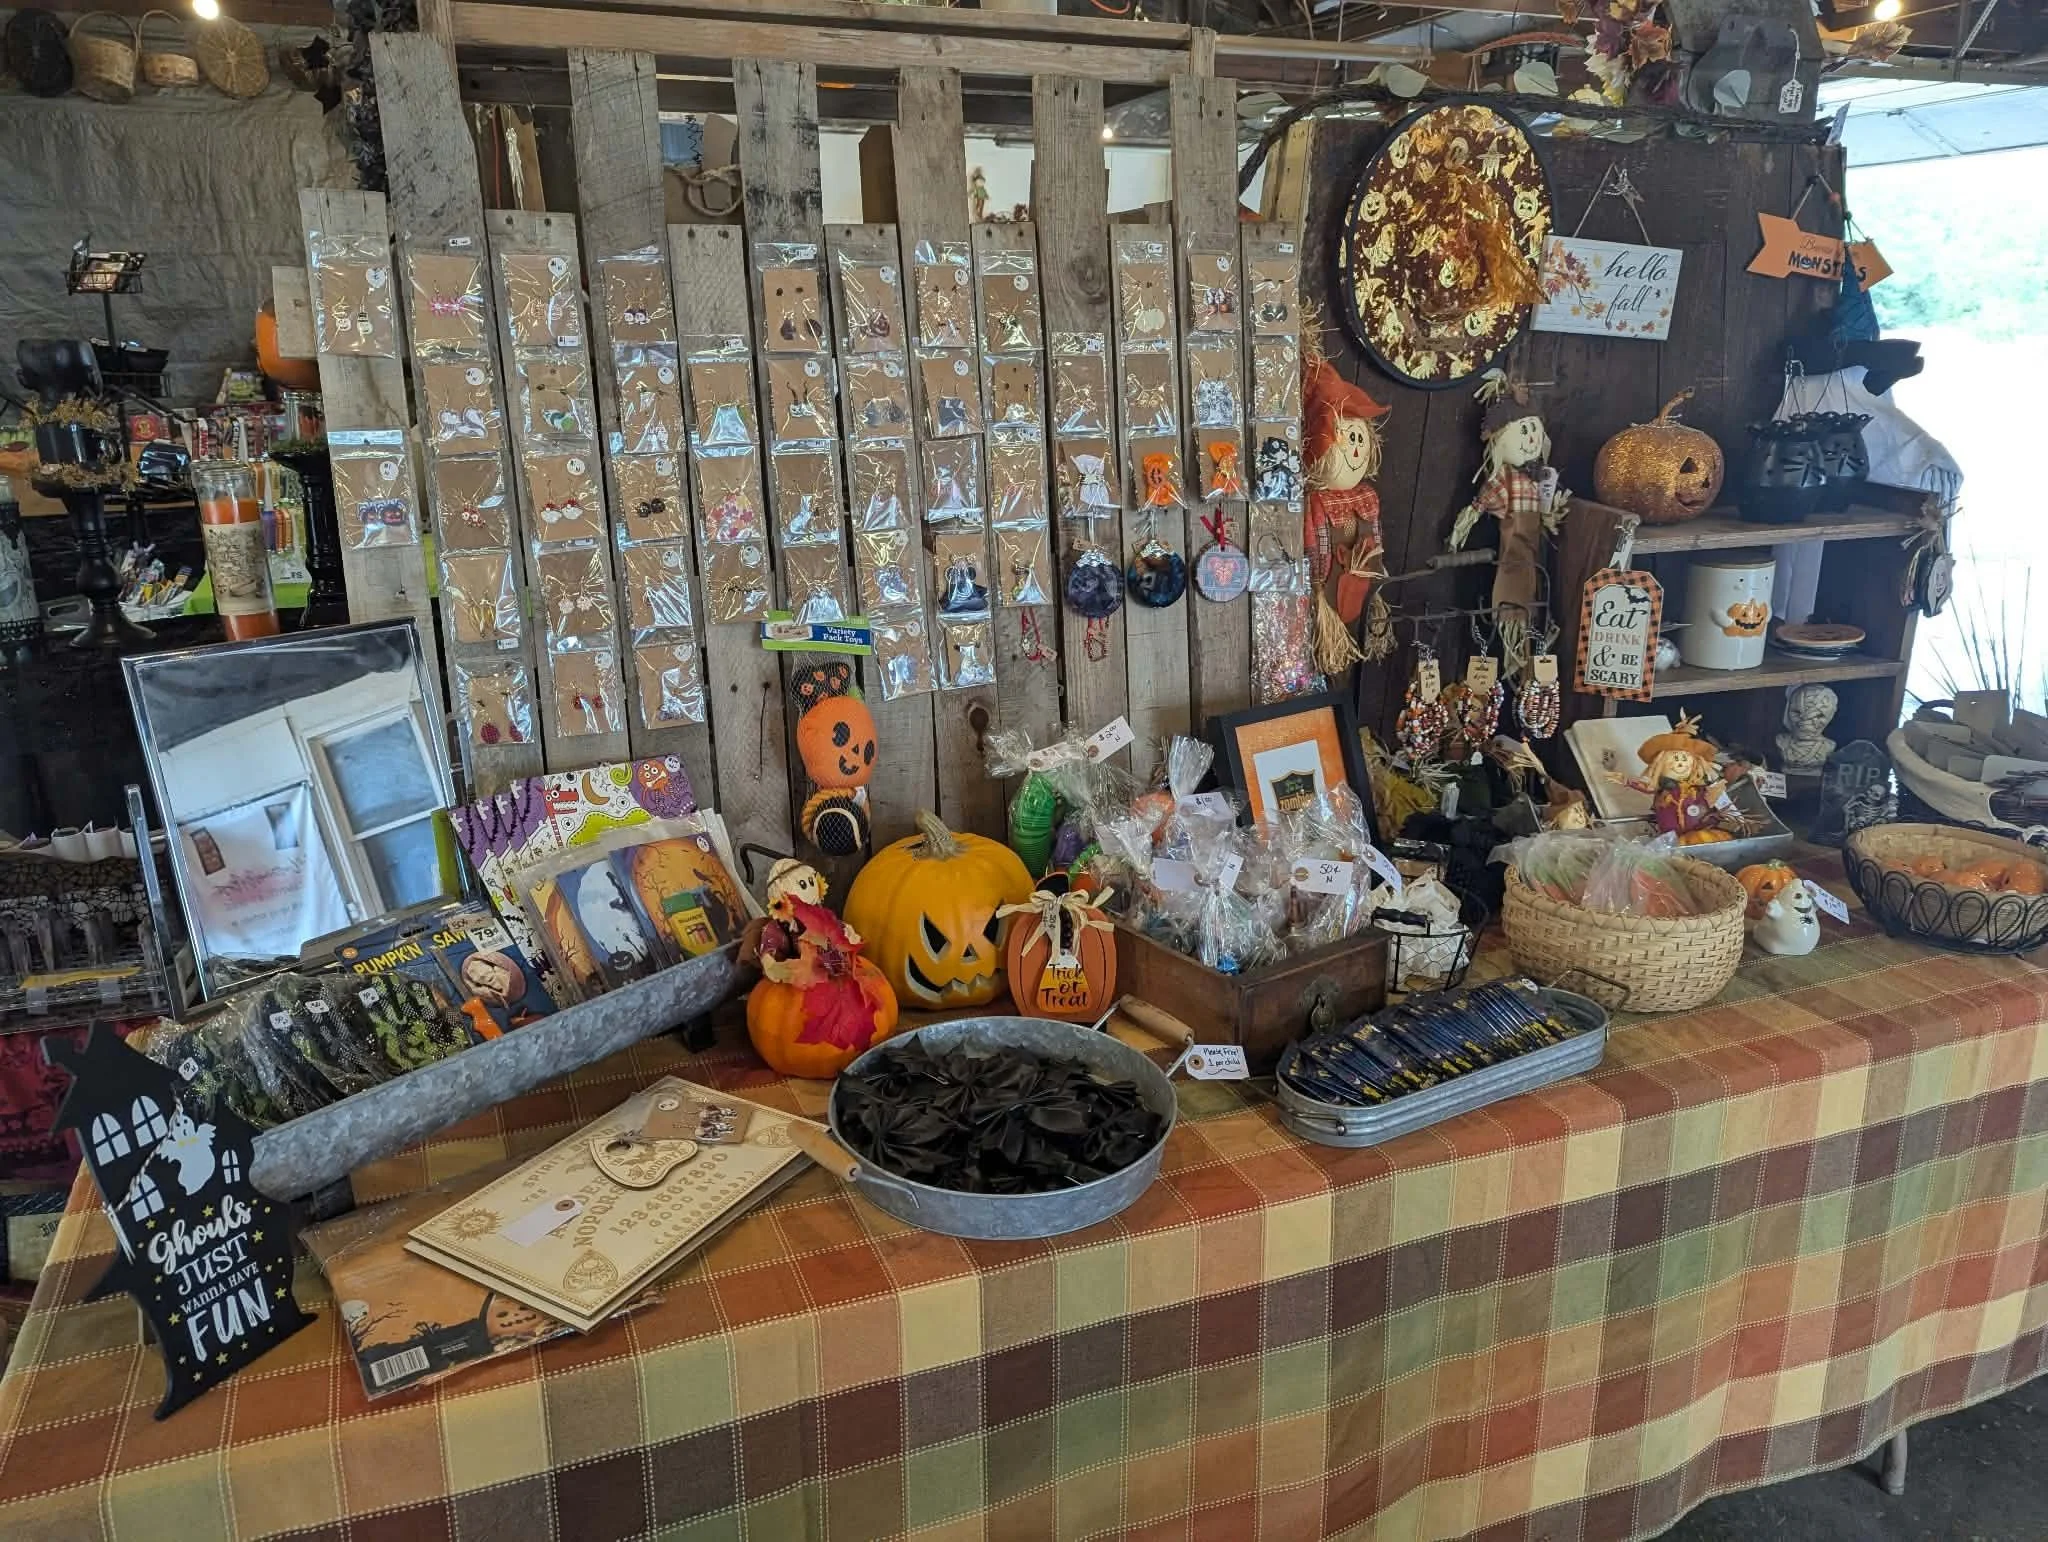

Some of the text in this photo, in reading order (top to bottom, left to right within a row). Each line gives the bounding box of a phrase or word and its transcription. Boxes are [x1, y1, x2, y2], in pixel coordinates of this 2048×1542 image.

[1604, 250, 1668, 281] hello
[1788, 250, 1867, 282] MONSTS
[1605, 284, 1653, 330] fall
[1595, 600, 1648, 630] Eat
[823, 633, 863, 645] Pack Toys
[827, 626, 857, 637] Variety
[1594, 631, 1641, 646] DRINK
[1593, 645, 1639, 668] & BE
[1590, 669, 1640, 685] SCARY
[1838, 763, 1881, 788] RIP
[1048, 963, 1083, 981] Trick
[1041, 987, 1087, 1008] Treat
[1059, 981, 1082, 995] or
[148, 1195, 252, 1275] Ghouls
[174, 1232, 249, 1296] JUST
[227, 1261, 260, 1288] HAVE
